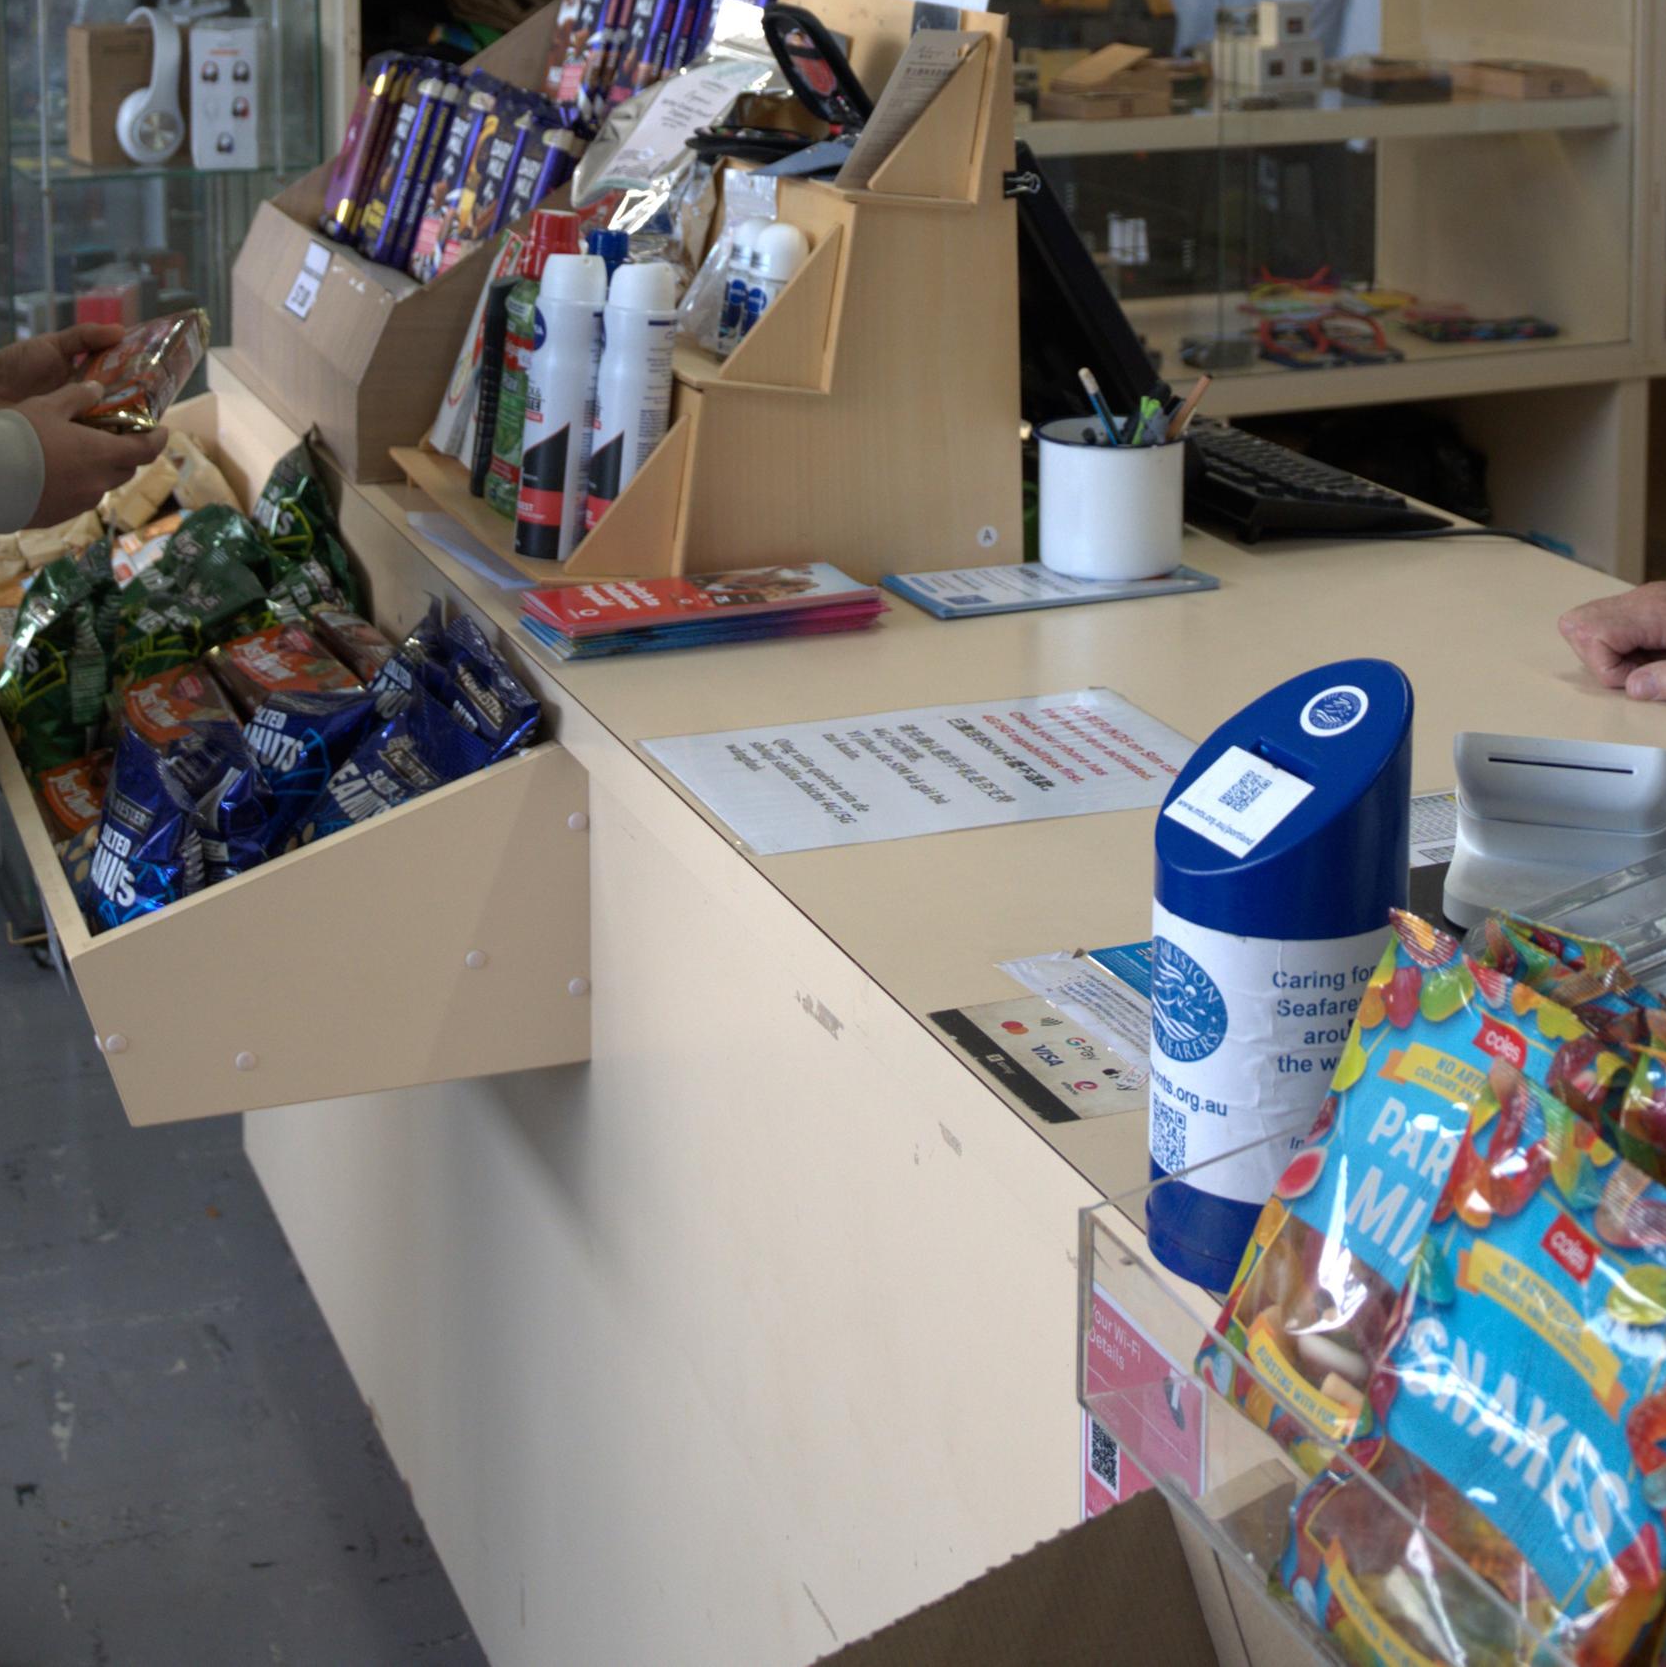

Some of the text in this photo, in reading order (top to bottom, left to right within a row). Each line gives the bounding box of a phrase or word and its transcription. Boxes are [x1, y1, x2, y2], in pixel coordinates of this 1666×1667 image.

[982, 529, 993, 542] A
[977, 714, 1091, 784] 4G/5G capabilities first.
[1005, 711, 1113, 775] Check your phone has
[1124, 743, 1149, 752] on
[1137, 751, 1170, 764] Sim
[874, 754, 914, 774] de SIM
[1101, 750, 1160, 780] activated.
[814, 800, 858, 824] 4G/5G
[849, 802, 873, 812] de
[1272, 965, 1376, 992] Caring for
[1276, 998, 1360, 1019] Seafare
[1303, 1029, 1351, 1046] arou
[1485, 1030, 1521, 1063] coles
[1031, 1044, 1064, 1067] VISA
[1078, 1046, 1100, 1061] Pay
[1278, 1053, 1340, 1073] the w
[1436, 1057, 1455, 1073] NO
[1415, 1065, 1459, 1095] COLOURS
[1367, 1097, 1463, 1187] PAR
[1549, 1229, 1590, 1273] coles
[1115, 1326, 1142, 1365] Wi-Fi
[1256, 1344, 1293, 1399] BURSTING
[1403, 1317, 1631, 1551] SNAKES
